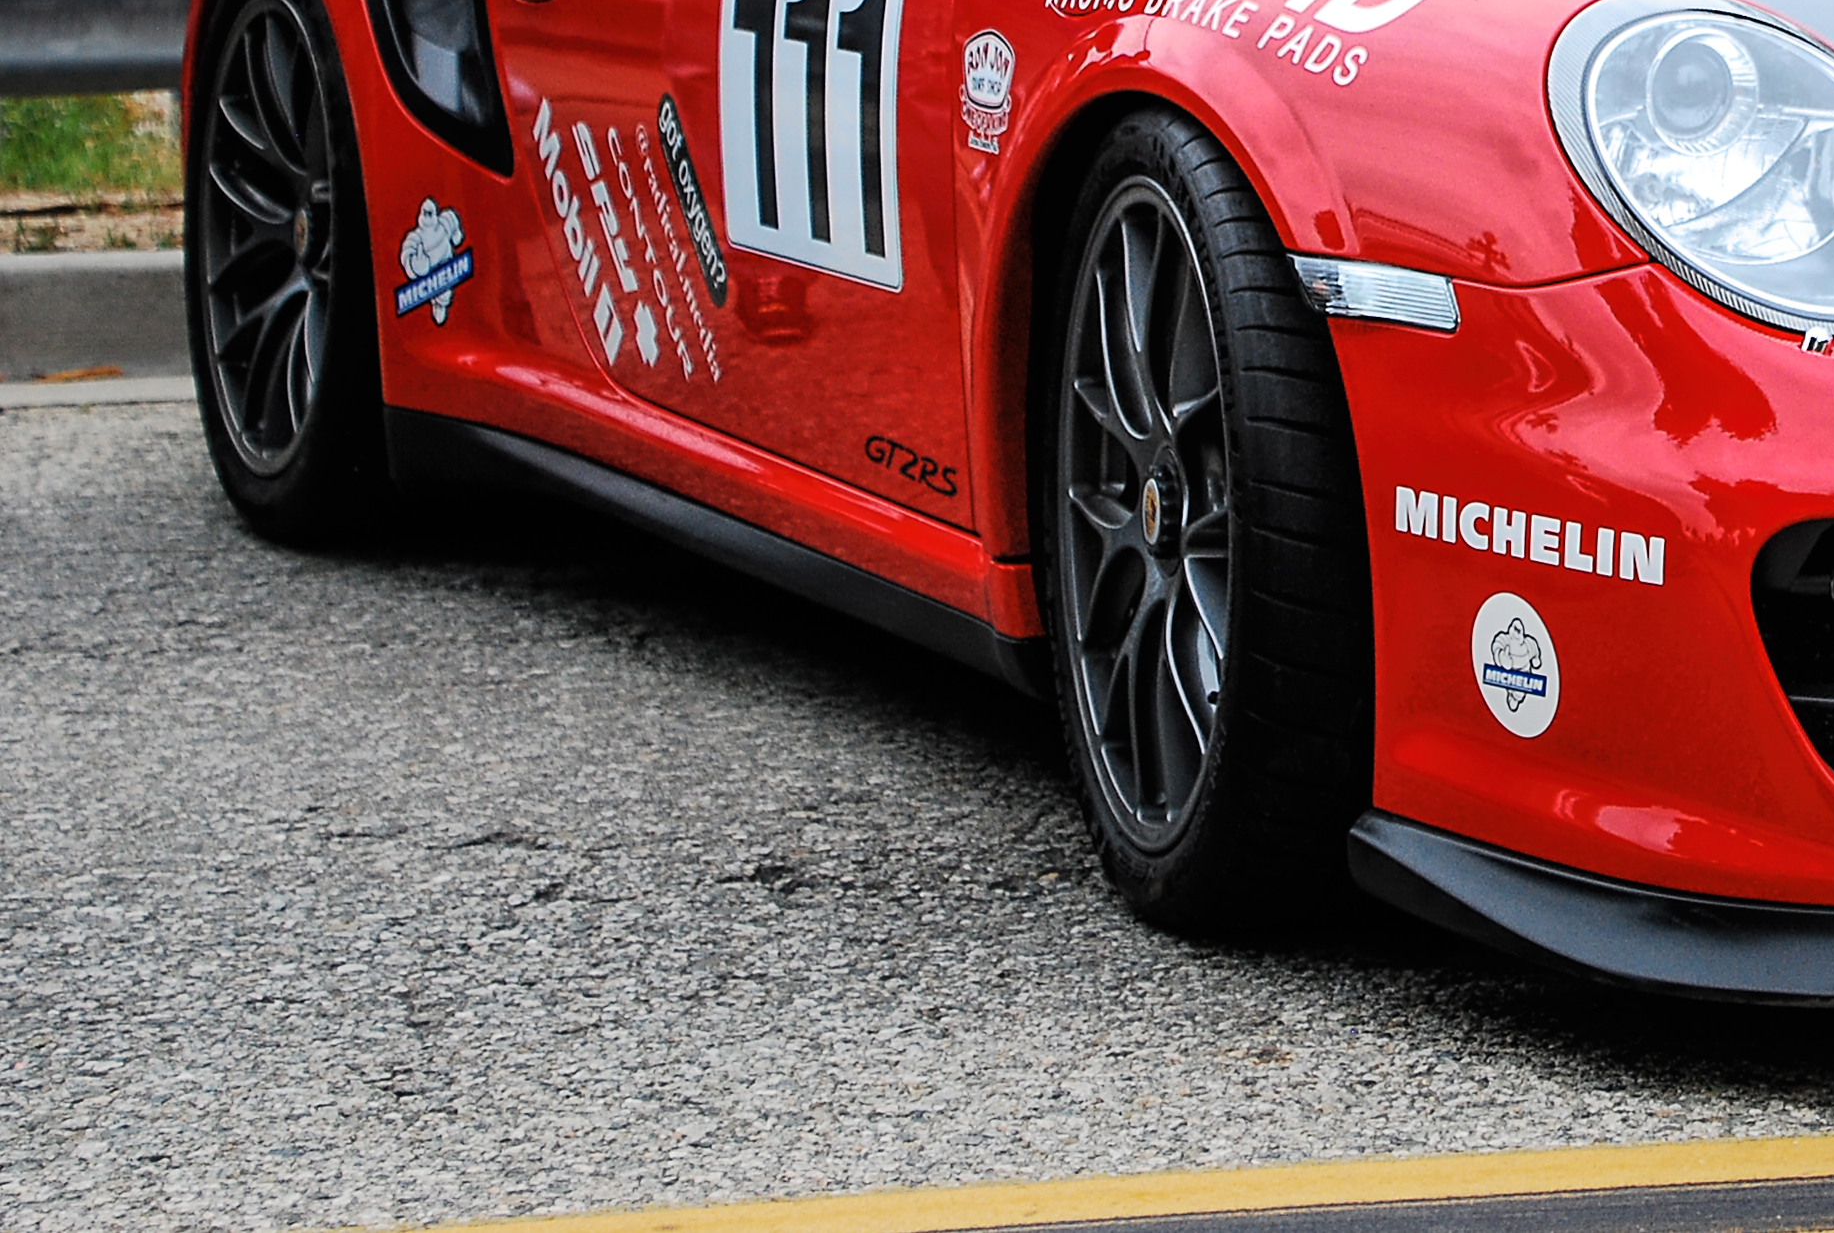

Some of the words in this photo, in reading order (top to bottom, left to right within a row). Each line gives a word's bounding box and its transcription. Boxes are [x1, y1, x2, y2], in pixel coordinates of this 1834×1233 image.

[1257, 14, 1368, 87] PADS
[532, 96, 600, 298] Mobil
[607, 126, 693, 383] CONTOUR
[636, 123, 721, 384] @radical.media
[657, 101, 684, 161] got
[678, 159, 727, 289] oxygen?
[398, 256, 469, 310] MICHELIN
[1395, 485, 1666, 586] MICHELIN
[1485, 668, 1544, 692] MICHELIN
